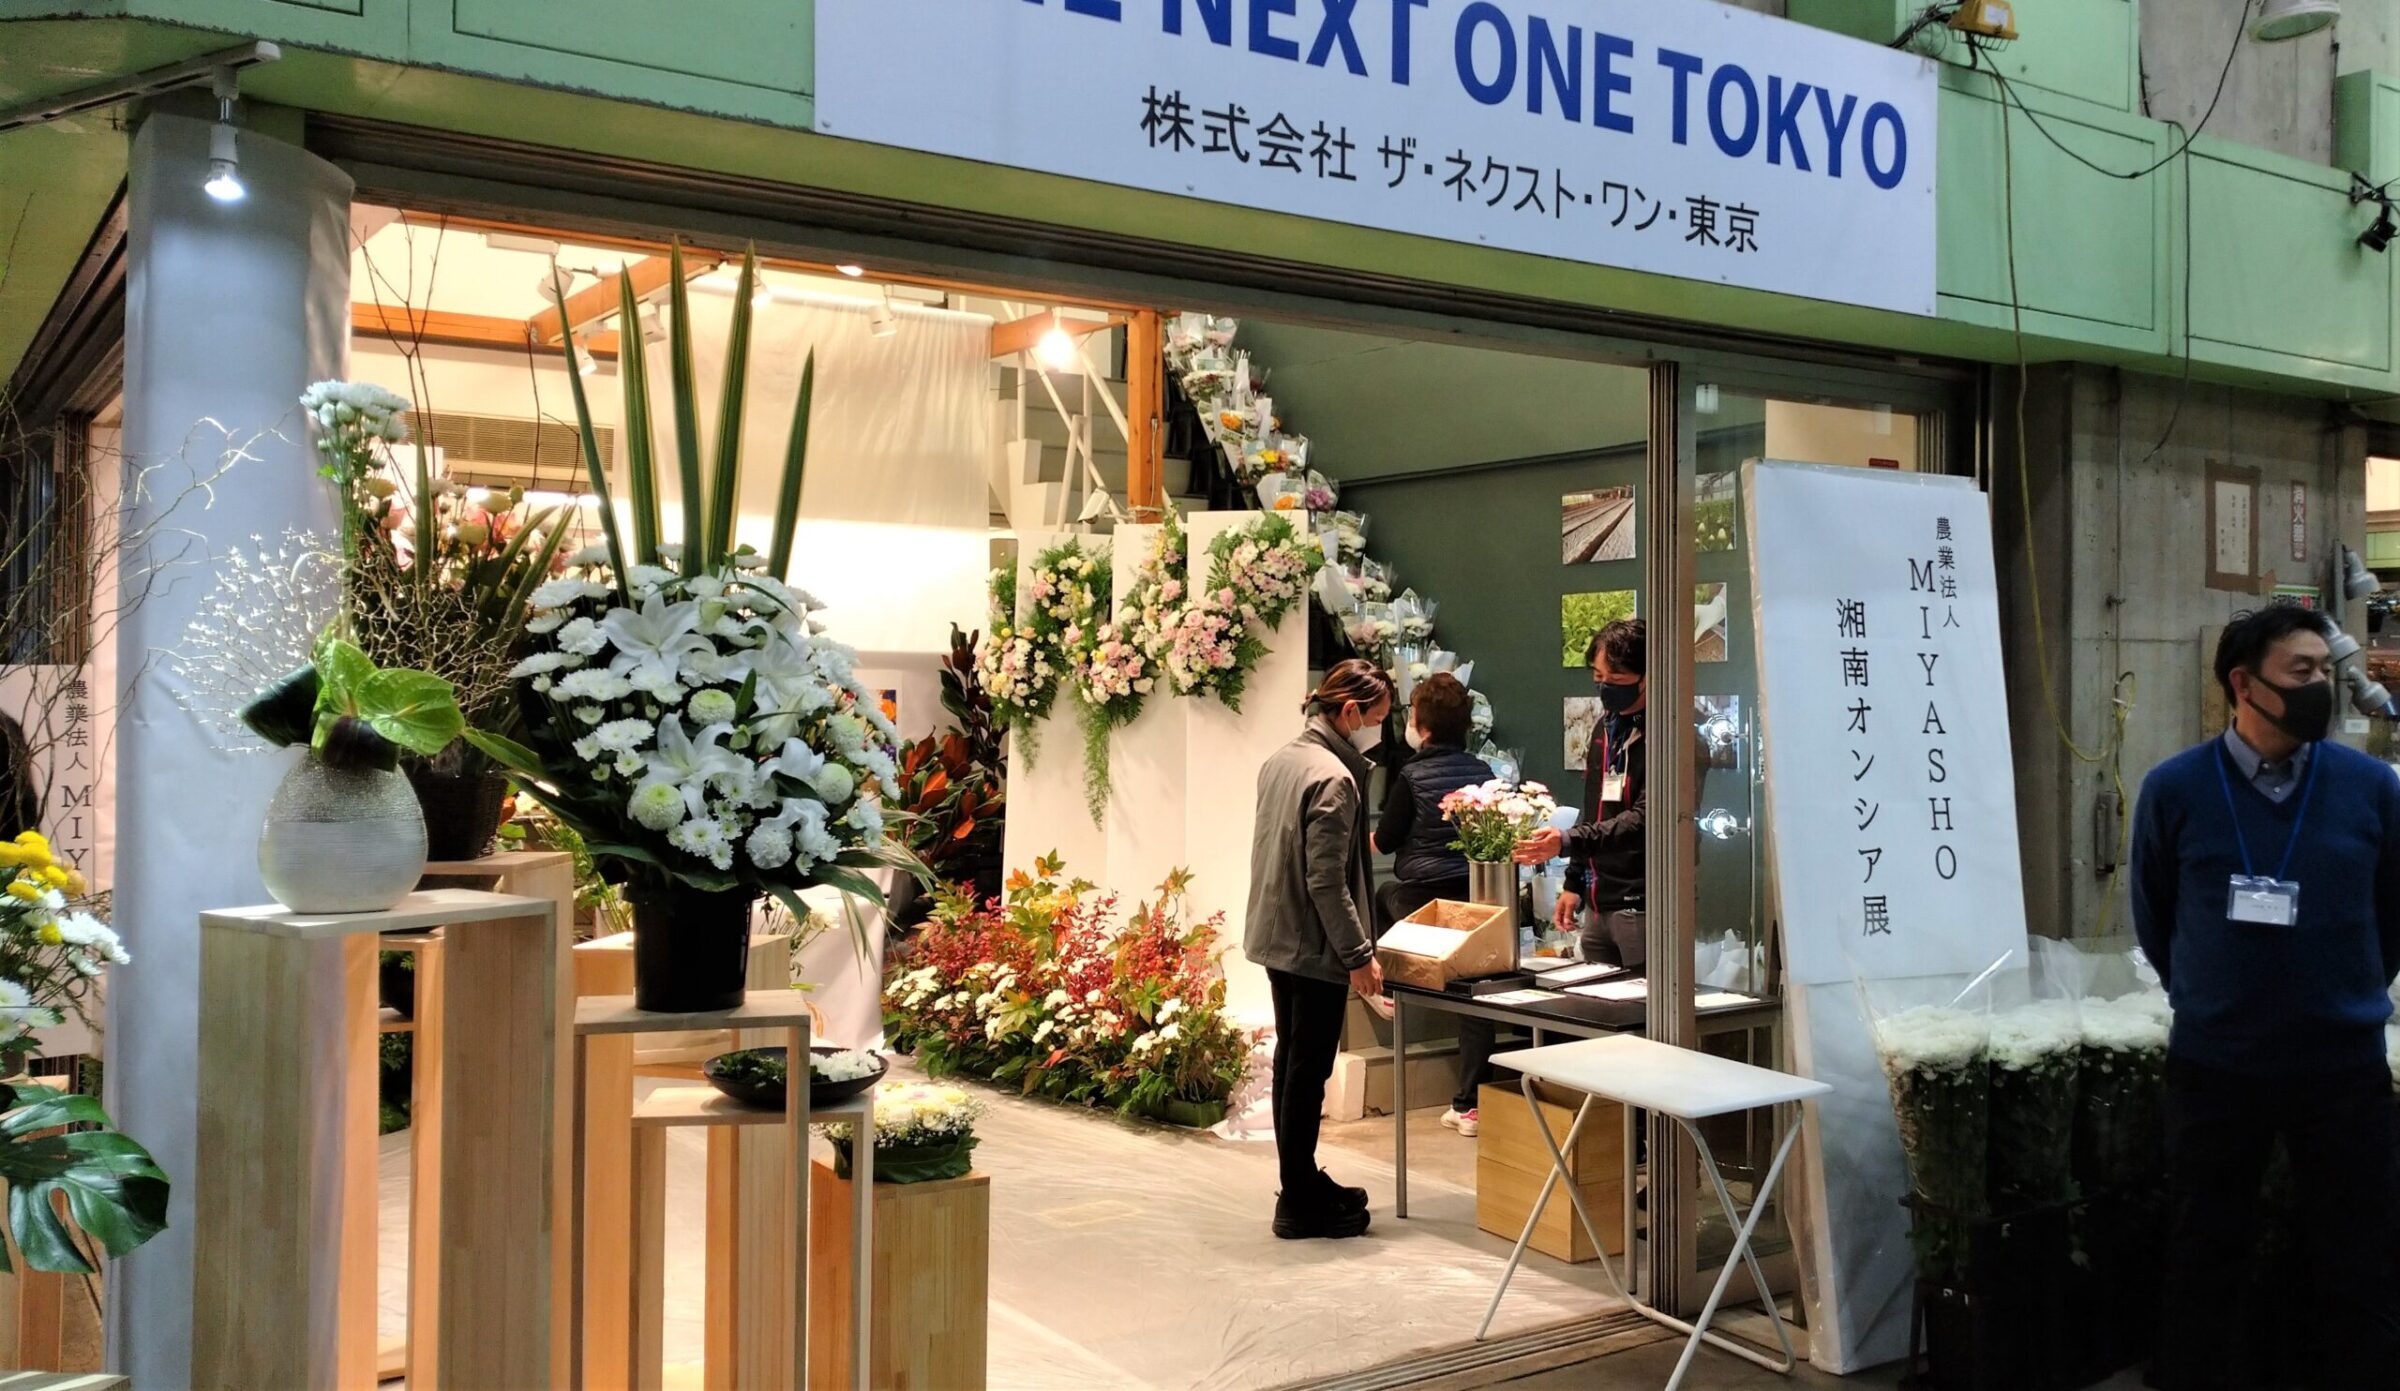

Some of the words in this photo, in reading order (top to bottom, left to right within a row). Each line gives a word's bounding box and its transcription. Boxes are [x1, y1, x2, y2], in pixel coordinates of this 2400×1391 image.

[1140, 85, 1357, 182] 株式会社
[1454, 0, 1634, 134] ONE
[1657, 47, 1907, 190] TOKYO
[1935, 516, 1960, 629] 農業法人
[1836, 598, 1892, 937] 湘南オンシア展
[1908, 558, 1957, 880] MIYASHO
